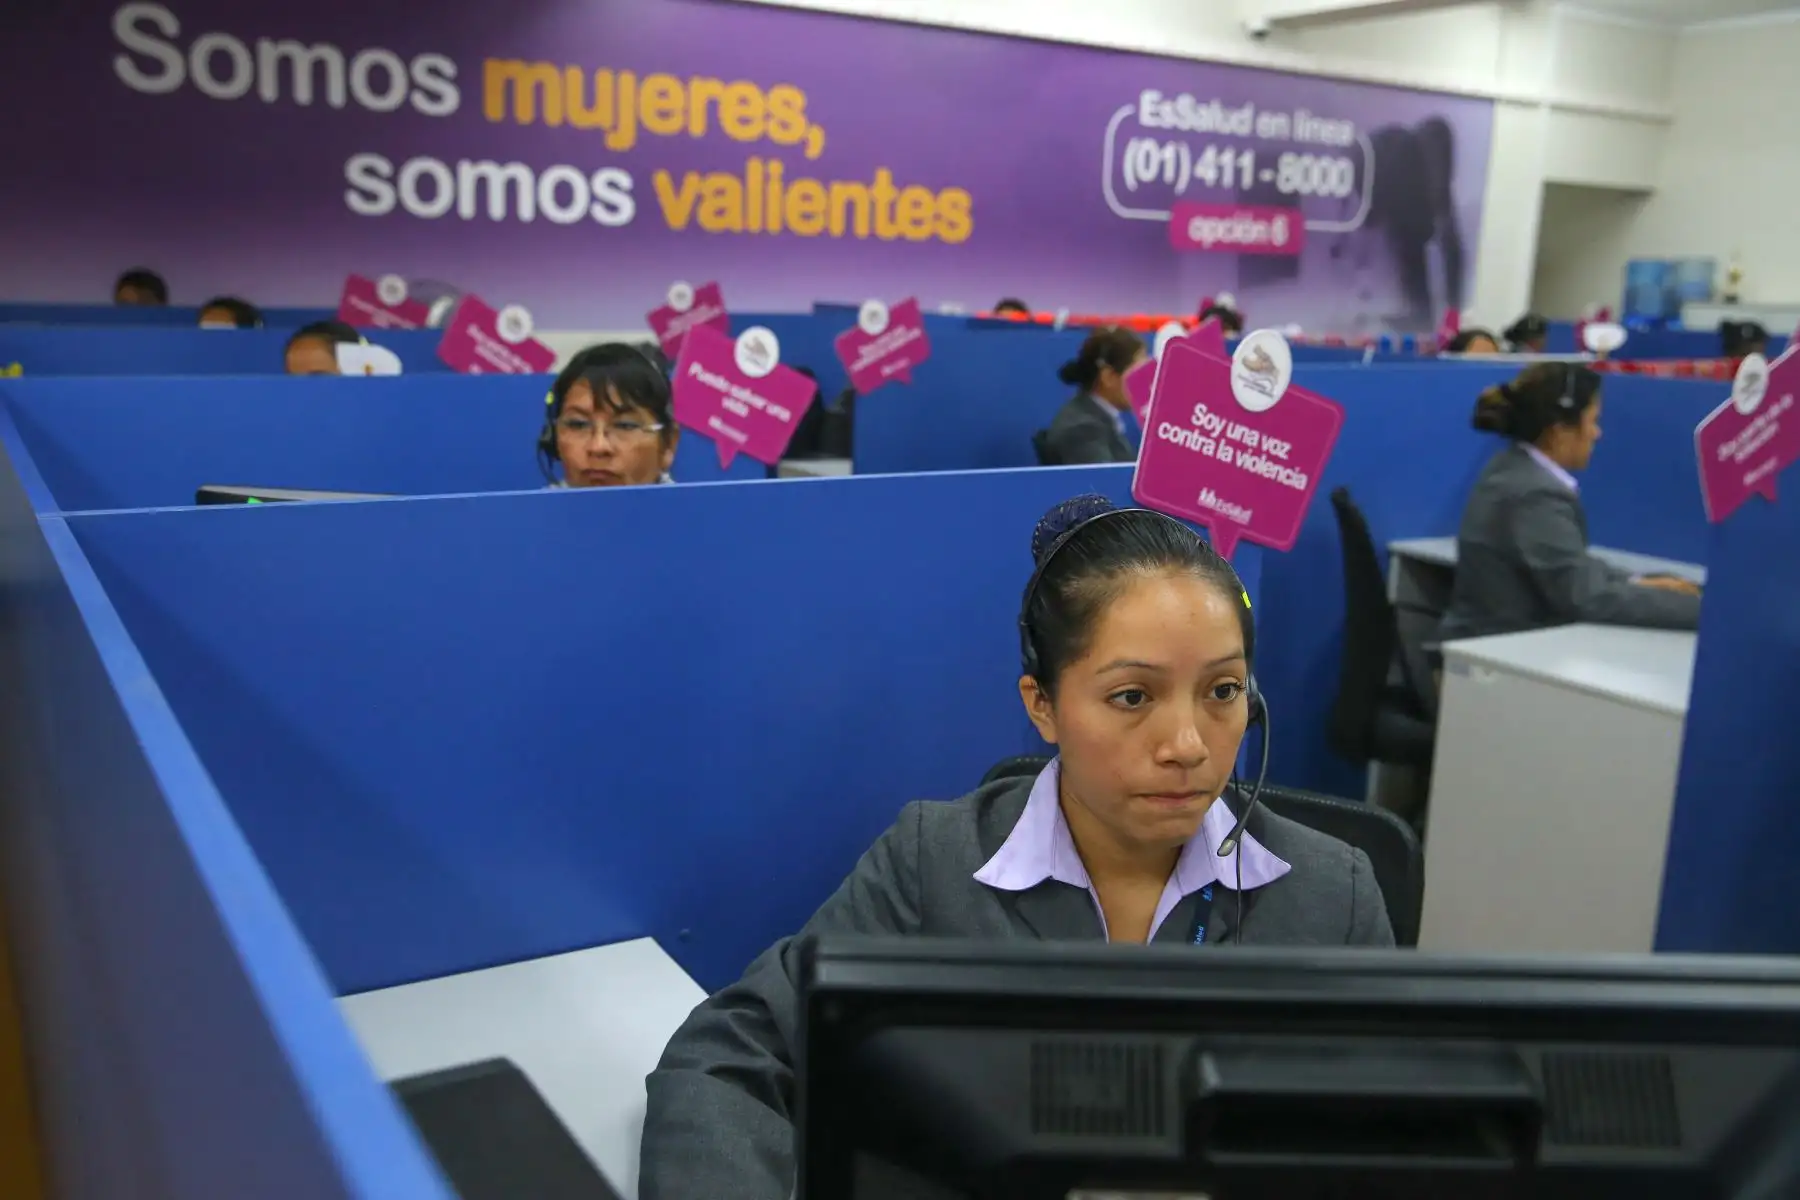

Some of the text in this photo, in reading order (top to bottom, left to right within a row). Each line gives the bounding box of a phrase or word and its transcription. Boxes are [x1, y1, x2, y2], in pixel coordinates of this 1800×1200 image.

[112, 2, 826, 160] Somos mujeres,
[1139, 89, 1254, 137] EsSalud
[1255, 110, 1291, 141] en
[343, 152, 975, 243] somos valientes
[1123, 137, 1191, 196] (01)
[1157, 421, 1309, 491] contra la violencia
[1191, 402, 1292, 460] Soy una voz
